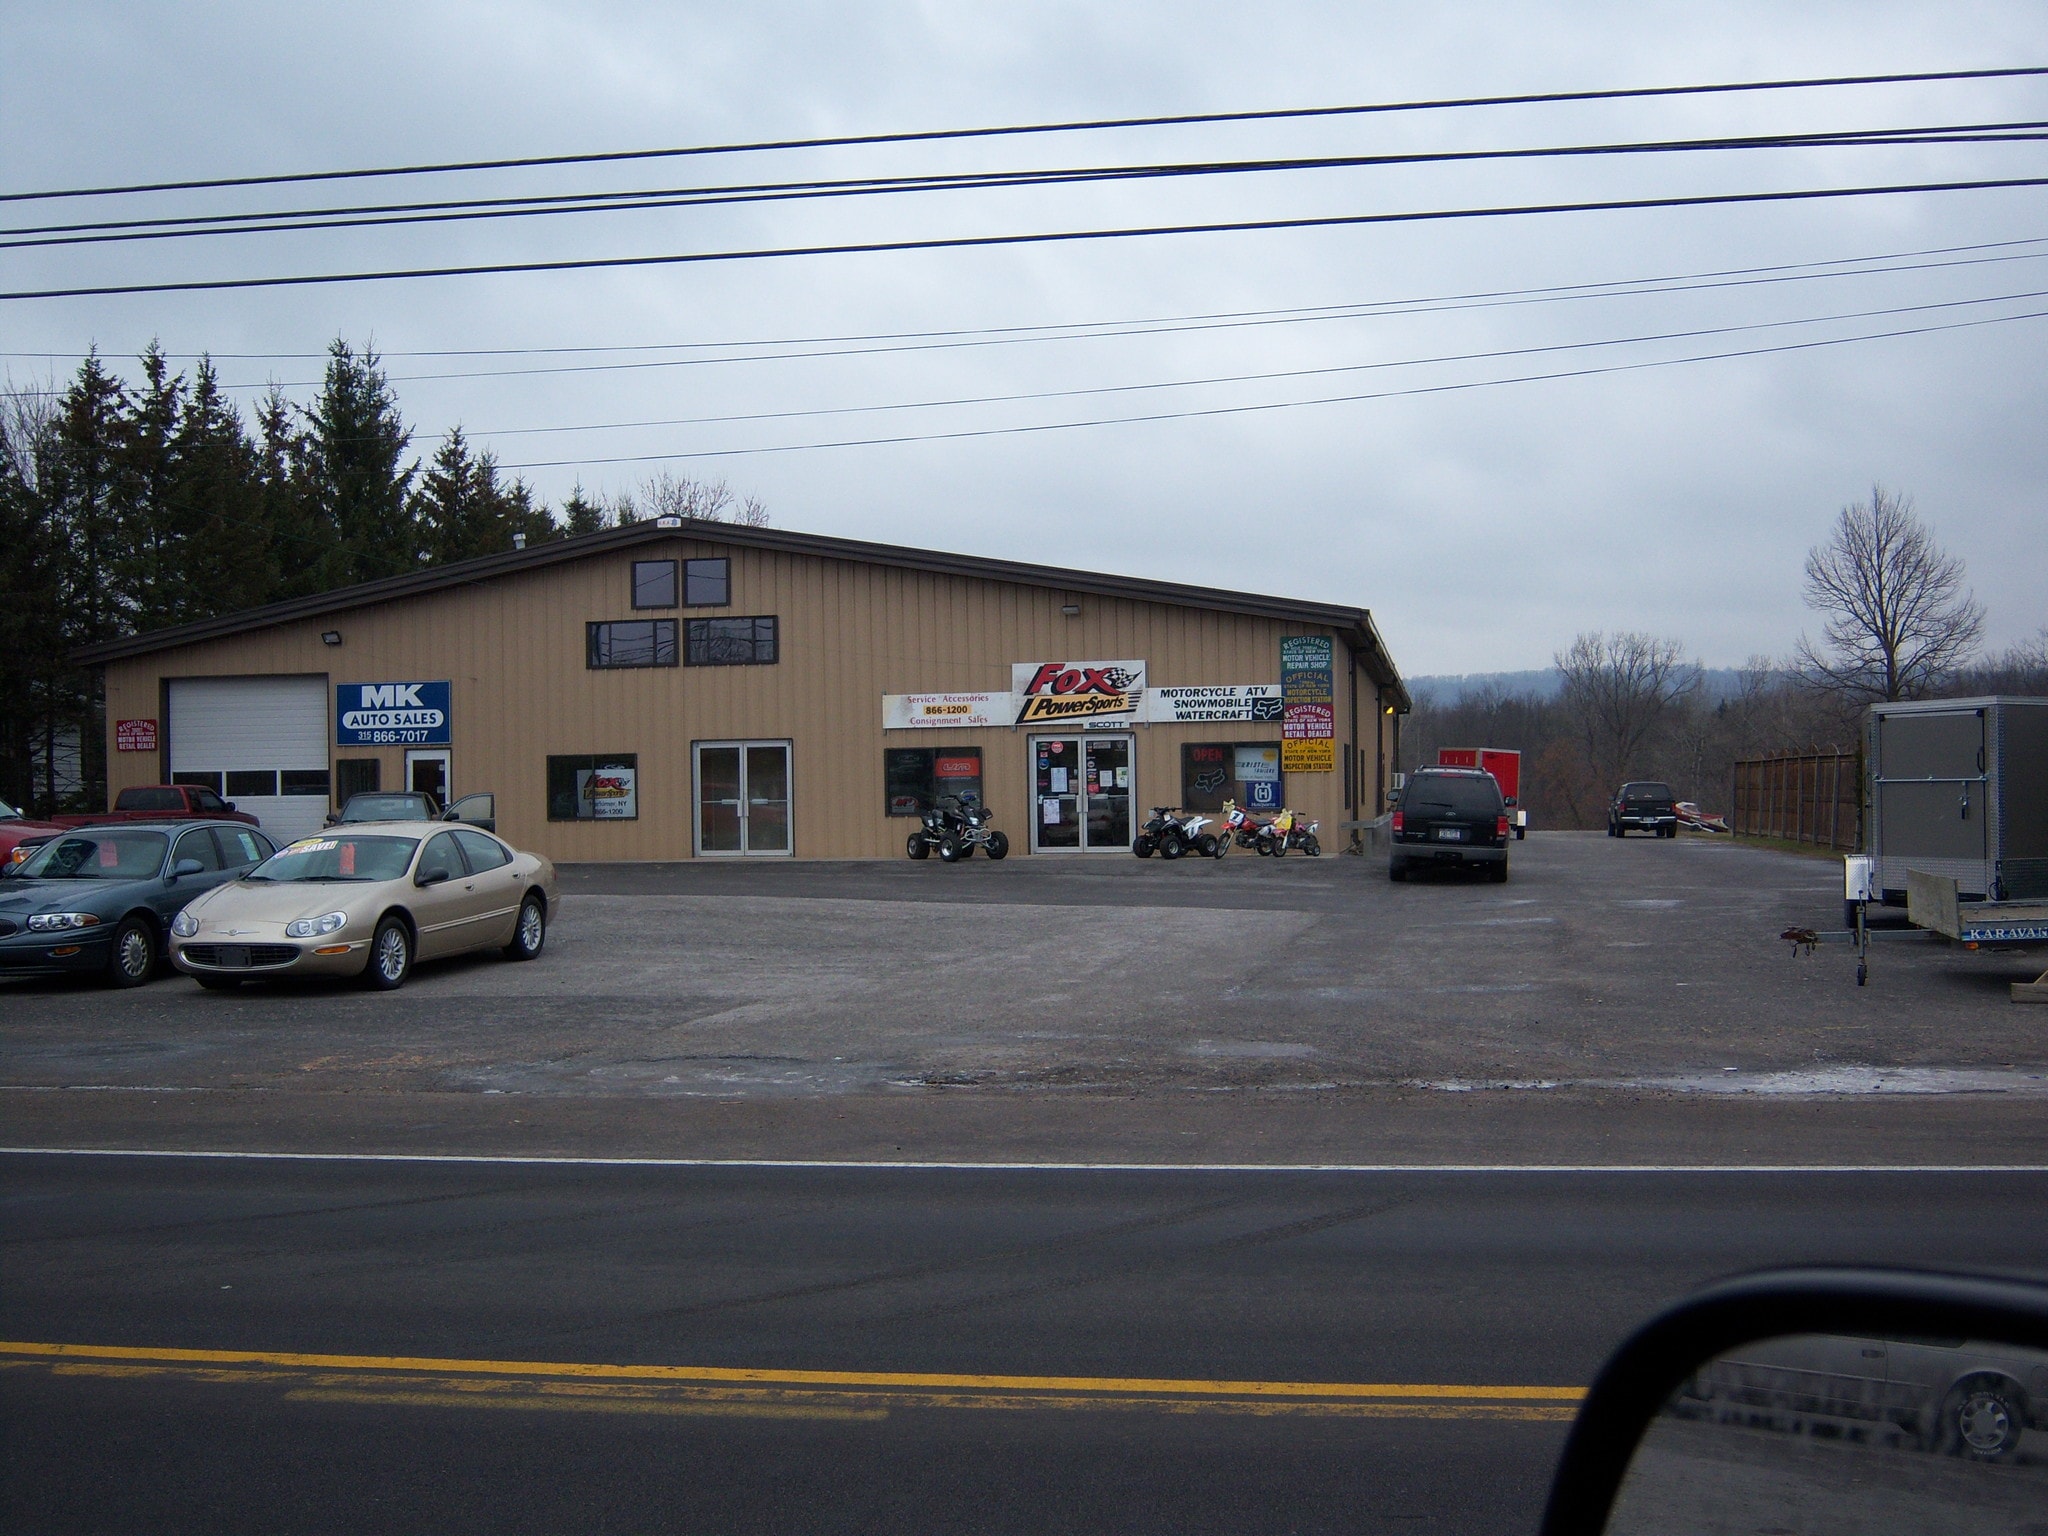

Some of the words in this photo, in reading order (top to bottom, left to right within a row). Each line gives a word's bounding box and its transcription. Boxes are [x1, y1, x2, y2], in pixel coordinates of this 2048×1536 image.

[1283, 637, 1329, 650] REGISTERED
[1286, 672, 1329, 683] OFFICIAL
[361, 684, 424, 709] MK
[1160, 687, 1237, 698] MOTORCYCLE
[1245, 687, 1268, 696] ATV
[942, 694, 989, 703] Accessories
[1173, 698, 1251, 708] SNOWMOBILE
[925, 705, 968, 715] 866-1200
[1032, 696, 1124, 716] PowerSports
[1175, 710, 1252, 720] WATERCRAFT
[1284, 705, 1331, 719] REGISTERED
[350, 714, 389, 726] AUTO
[394, 713, 436, 725] SALES
[910, 717, 961, 726] Consignment
[967, 715, 988, 723] Sales
[118, 721, 155, 732] REGISTERED
[1307, 722, 1332, 730] VEHICLE
[358, 731, 371, 740] 315
[373, 730, 428, 742] 866-7017
[1286, 739, 1329, 749] OFFICIAL
[1193, 748, 1223, 762] OPEN
